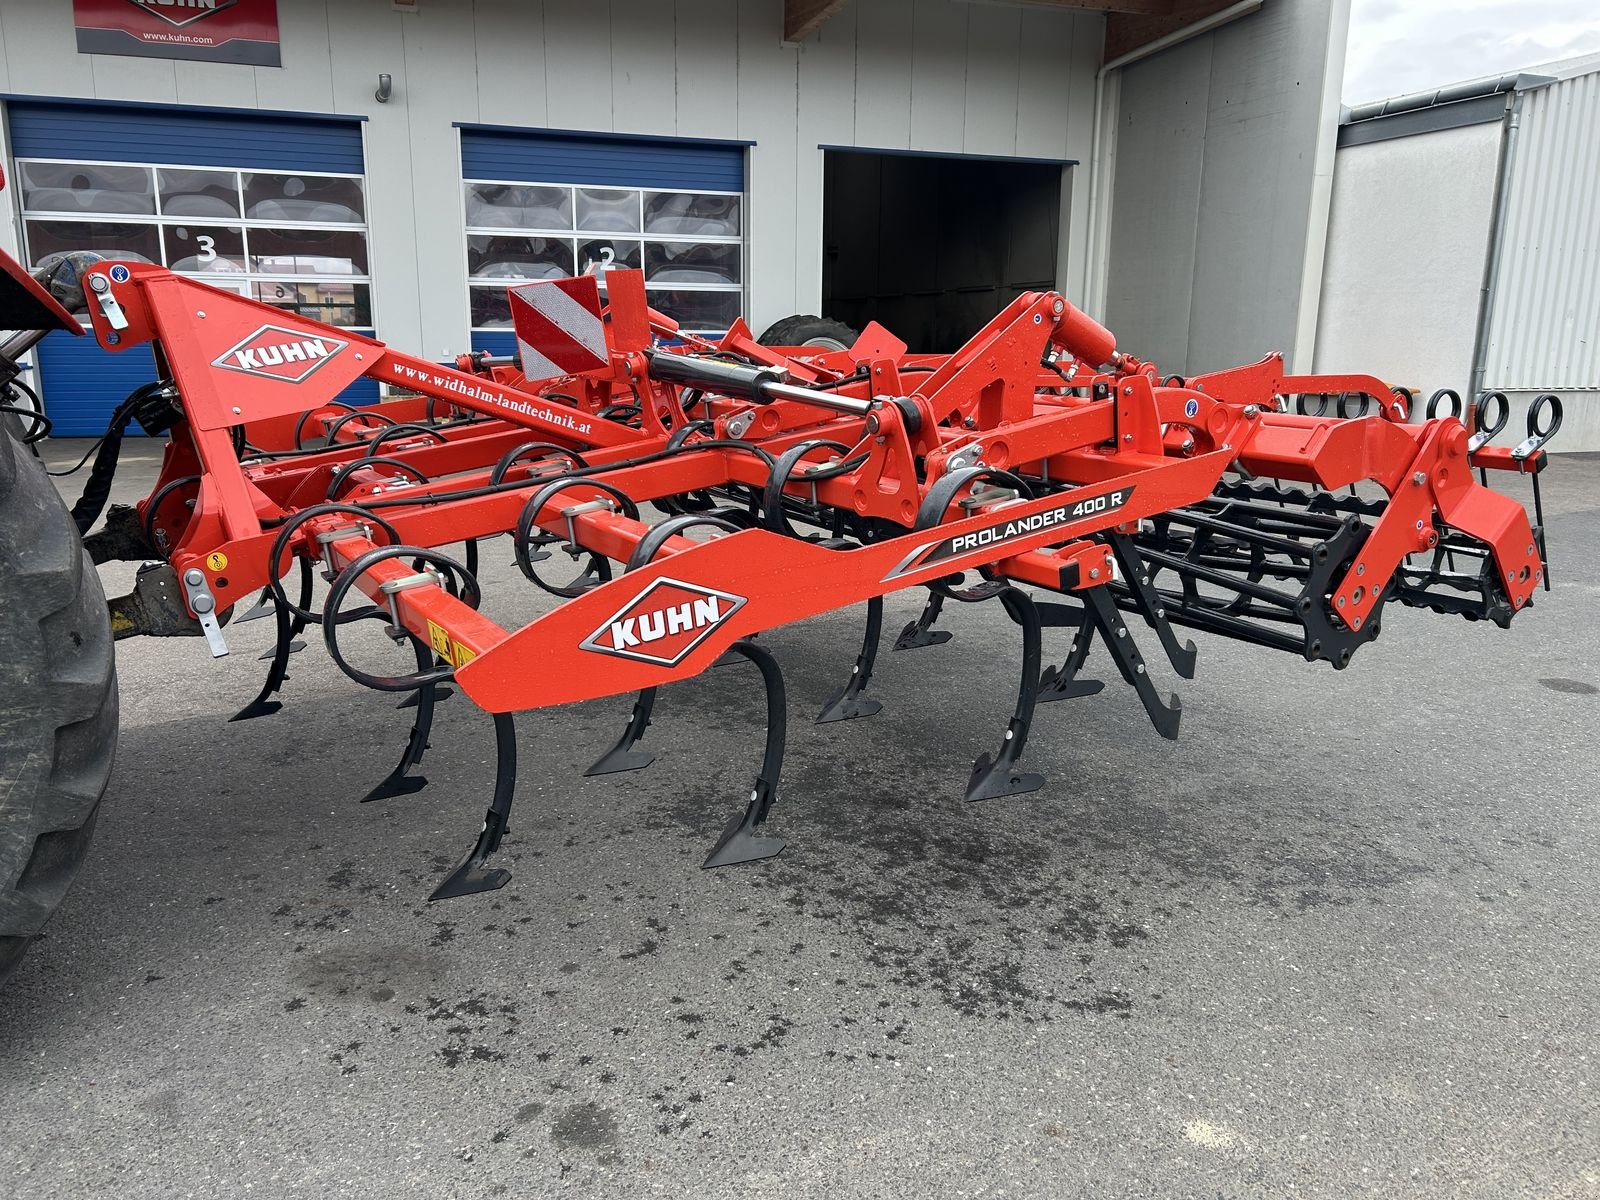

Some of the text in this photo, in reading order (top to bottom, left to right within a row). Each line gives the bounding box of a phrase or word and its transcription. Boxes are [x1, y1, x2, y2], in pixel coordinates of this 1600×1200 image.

[143, 32, 213, 45] www.kuhn.com
[196, 235, 217, 262] 3
[599, 246, 616, 271] 2
[234, 339, 330, 370] KUHN
[393, 362, 592, 435] www.widhalm-landtechnik.at
[952, 491, 1123, 553] PROLANDER 400 R
[610, 595, 721, 651] KUHN
